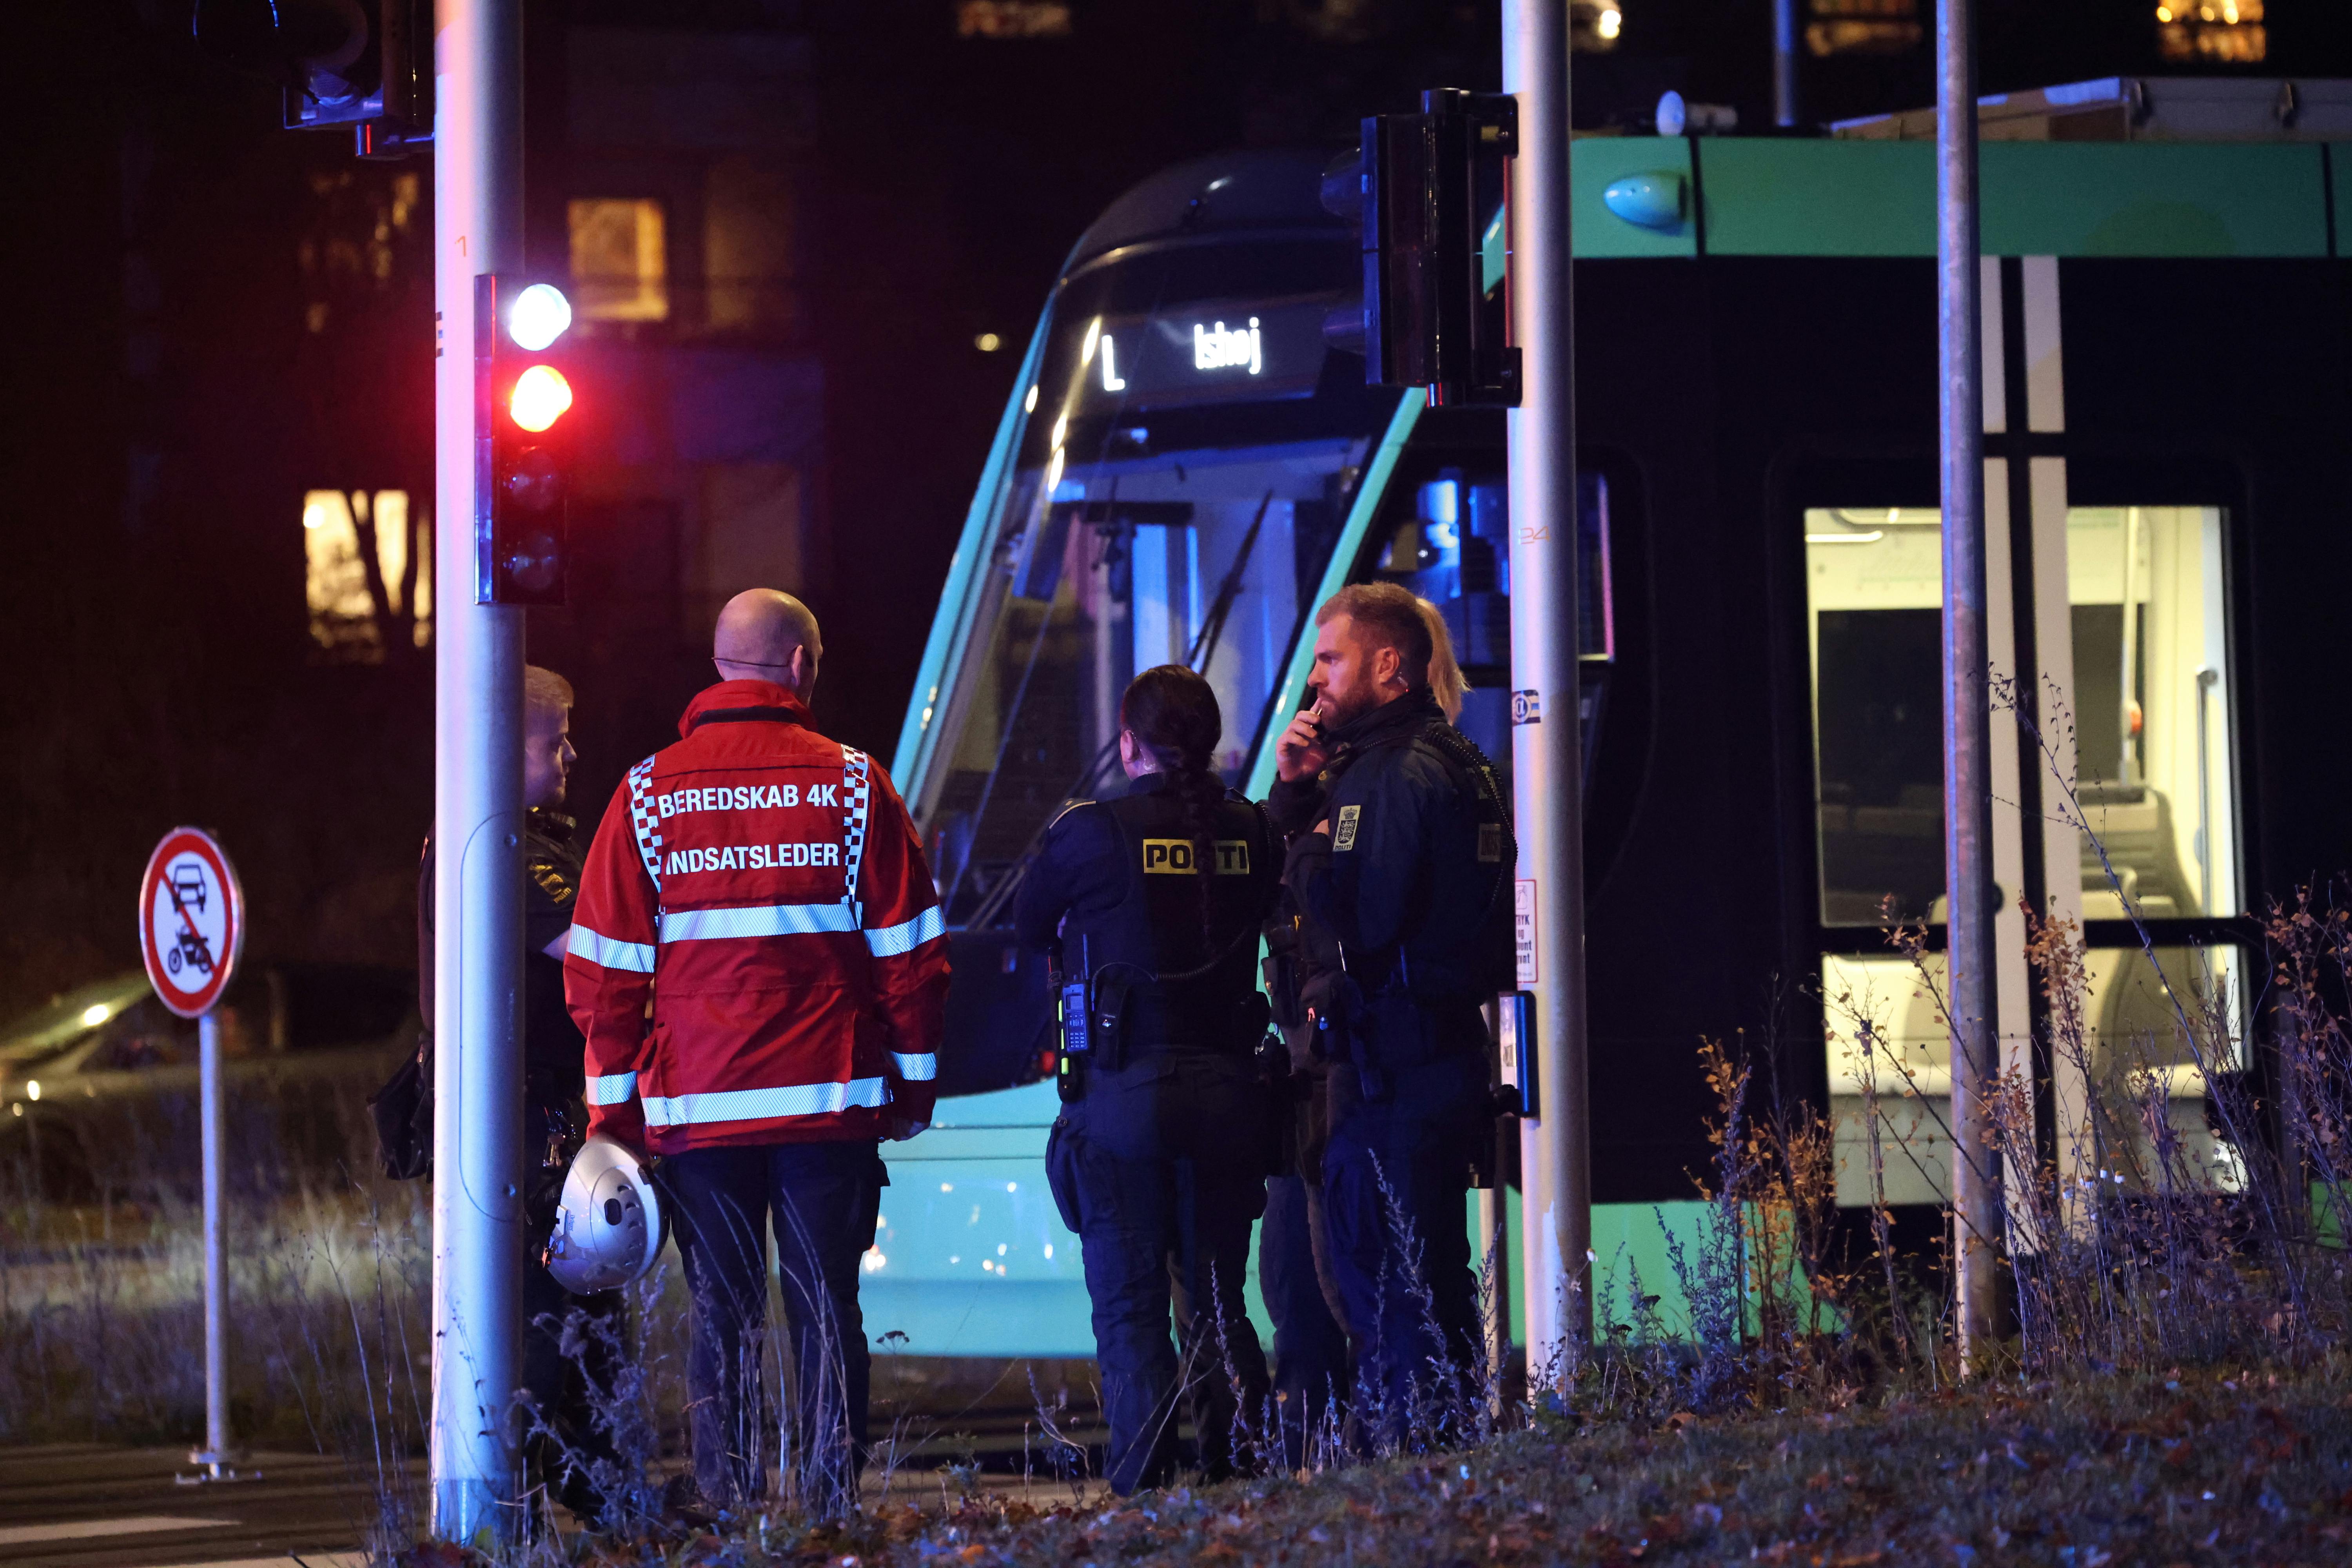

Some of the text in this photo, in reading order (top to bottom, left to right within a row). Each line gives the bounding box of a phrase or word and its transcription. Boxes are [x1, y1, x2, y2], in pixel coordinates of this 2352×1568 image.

[1102, 335, 1125, 391] L
[658, 784, 838, 818] BEREDSKAB 4K
[666, 843, 839, 875] INDSATSLEDER
[1146, 844, 1247, 869] POTI
